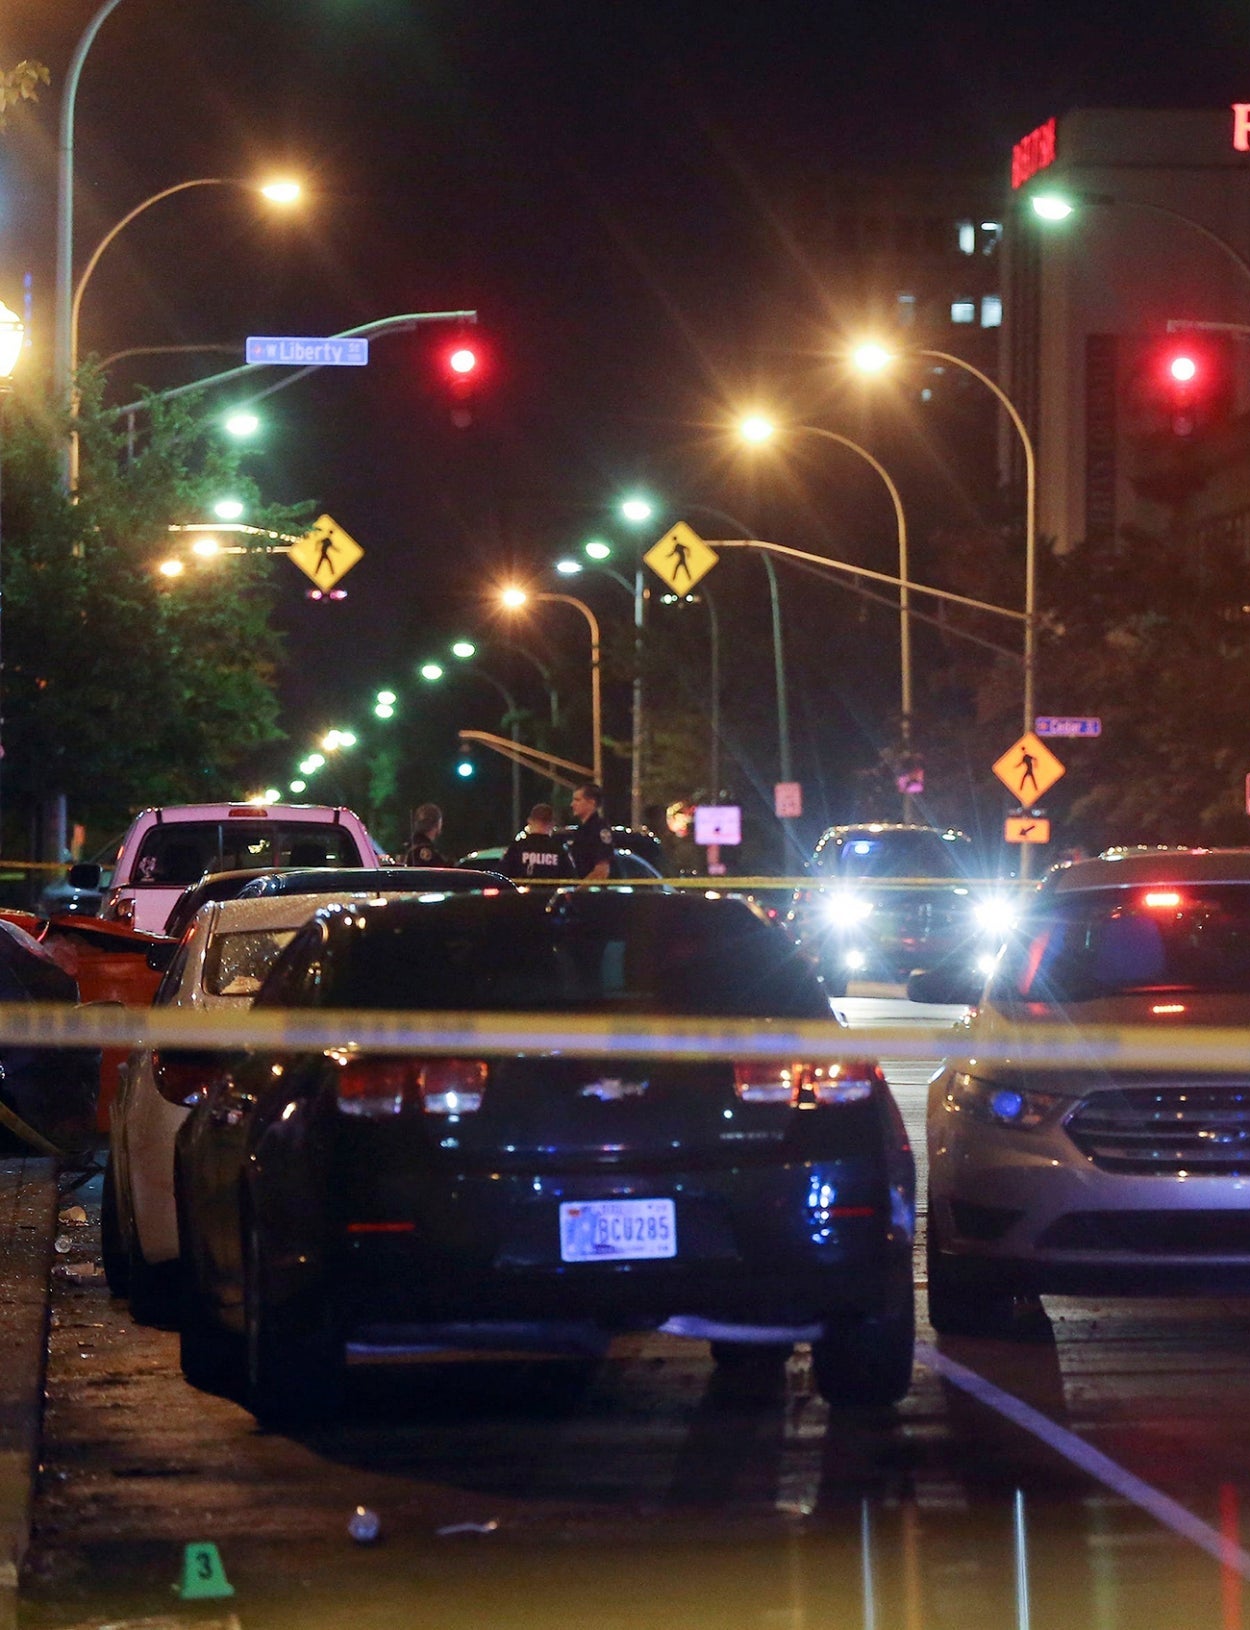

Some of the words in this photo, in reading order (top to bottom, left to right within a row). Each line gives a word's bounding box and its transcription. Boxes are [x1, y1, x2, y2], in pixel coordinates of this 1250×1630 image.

[281, 341, 343, 363] Liberty
[522, 851, 559, 866] POLICE
[195, 1551, 214, 1580] 3
